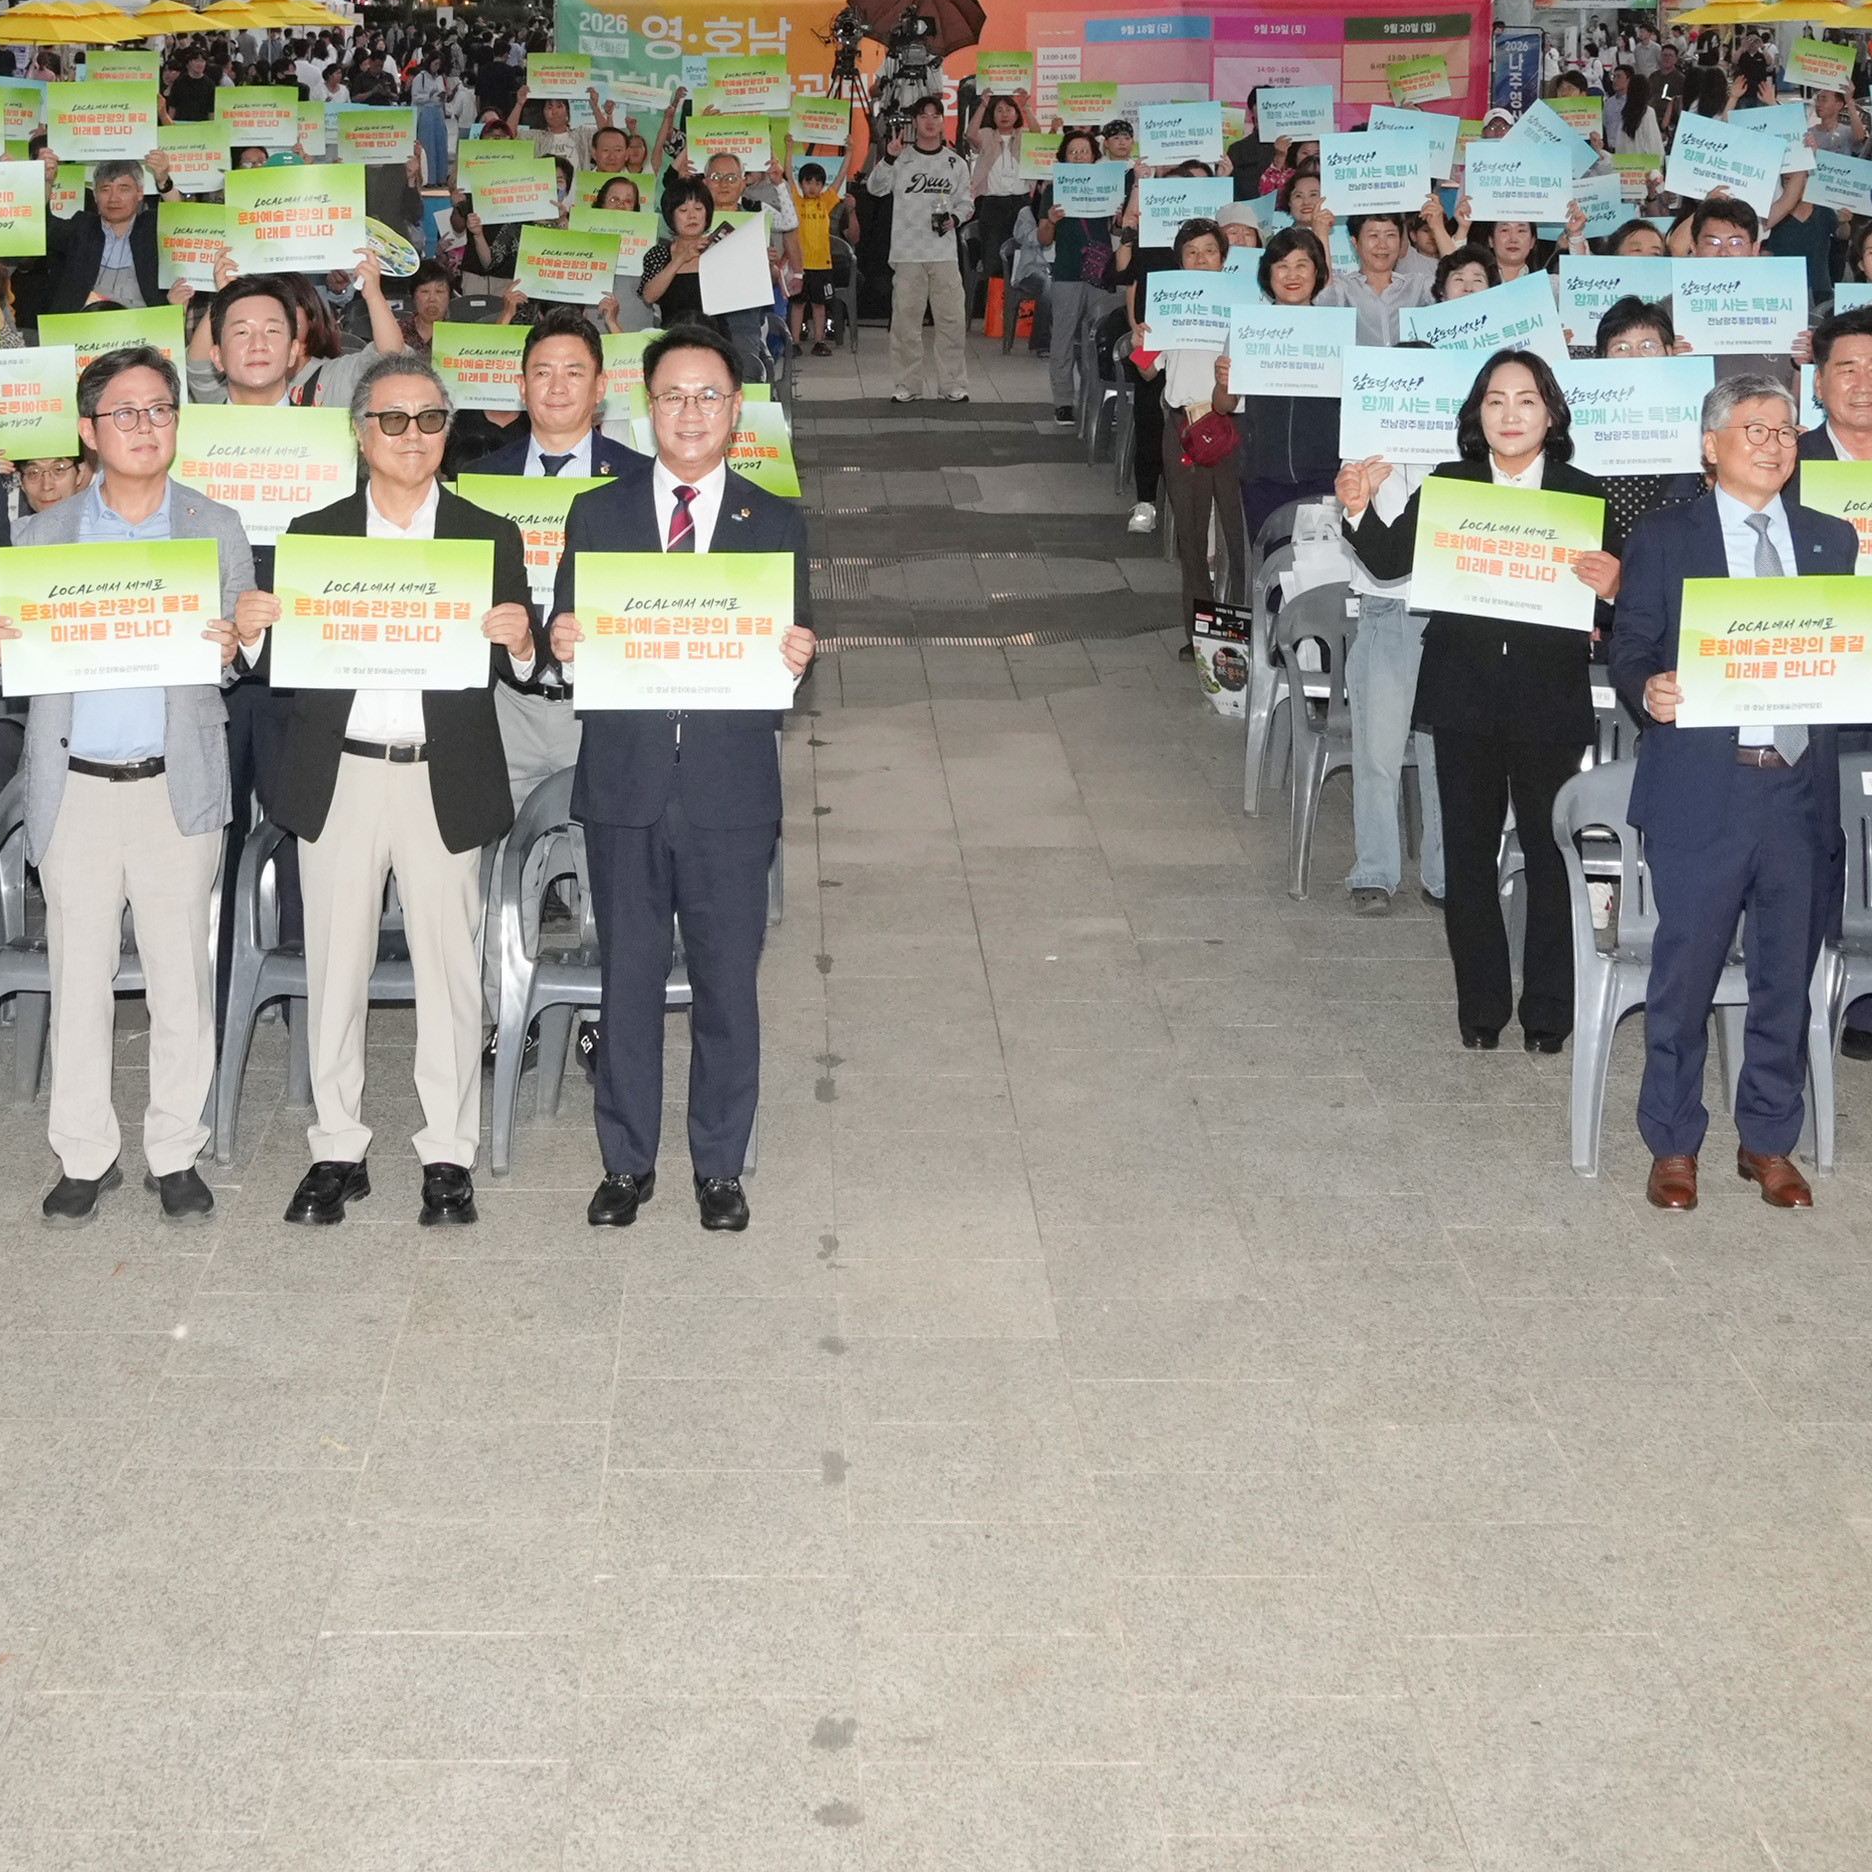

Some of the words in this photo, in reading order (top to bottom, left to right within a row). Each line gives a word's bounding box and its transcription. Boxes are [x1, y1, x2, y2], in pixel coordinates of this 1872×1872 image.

[579, 12, 629, 34] 2026
[1120, 24, 1135, 36] 9월
[1136, 23, 1156, 34] 18일
[1253, 24, 1268, 35] 9월
[1270, 24, 1290, 35] 19일
[1383, 22, 1398, 34] 9월
[1399, 22, 1419, 33] 20일
[641, 15, 793, 60] 영·호남
[1504, 41, 1529, 52] 2026
[1333, 167, 1357, 180] 함께
[1359, 165, 1382, 178] 사는
[1385, 163, 1418, 177] 특별시
[905, 172, 953, 195] Deus
[1347, 180, 1405, 191] 전남광주통합특별시
[1689, 298, 1718, 312] 함께
[1721, 297, 1748, 311] 사는
[1752, 297, 1792, 311] 특별시
[1706, 316, 1777, 326] 전남광주통합특별시
[47, 579, 121, 598] LOCAL에서
[124, 576, 169, 593] 세계로
[322, 579, 395, 595] LOCAL에서
[398, 581, 443, 596] 세계로
[19, 595, 155, 623] 문화예술관광의
[161, 593, 199, 613] 물결
[293, 597, 428, 619] 문화예술관광의
[433, 600, 471, 620] 물결
[623, 596, 696, 612] LOCAL에서
[699, 596, 744, 611] 세계로
[50, 622, 107, 644] 미래를
[113, 618, 172, 639] 만나다
[321, 623, 378, 642] 미래를
[384, 624, 442, 643] 만나다
[595, 615, 729, 636] 문화예술관광의
[735, 616, 773, 635] 물결
[1726, 617, 1795, 634] LOCAL에서
[1797, 616, 1839, 631] 세계로
[623, 641, 680, 660] 미래를
[687, 641, 744, 660] 만나다
[1698, 635, 1824, 658] 문화예술관광의
[1828, 634, 1864, 653] 물결
[1724, 660, 1778, 681] 미래를
[1783, 658, 1837, 678] 만나다
